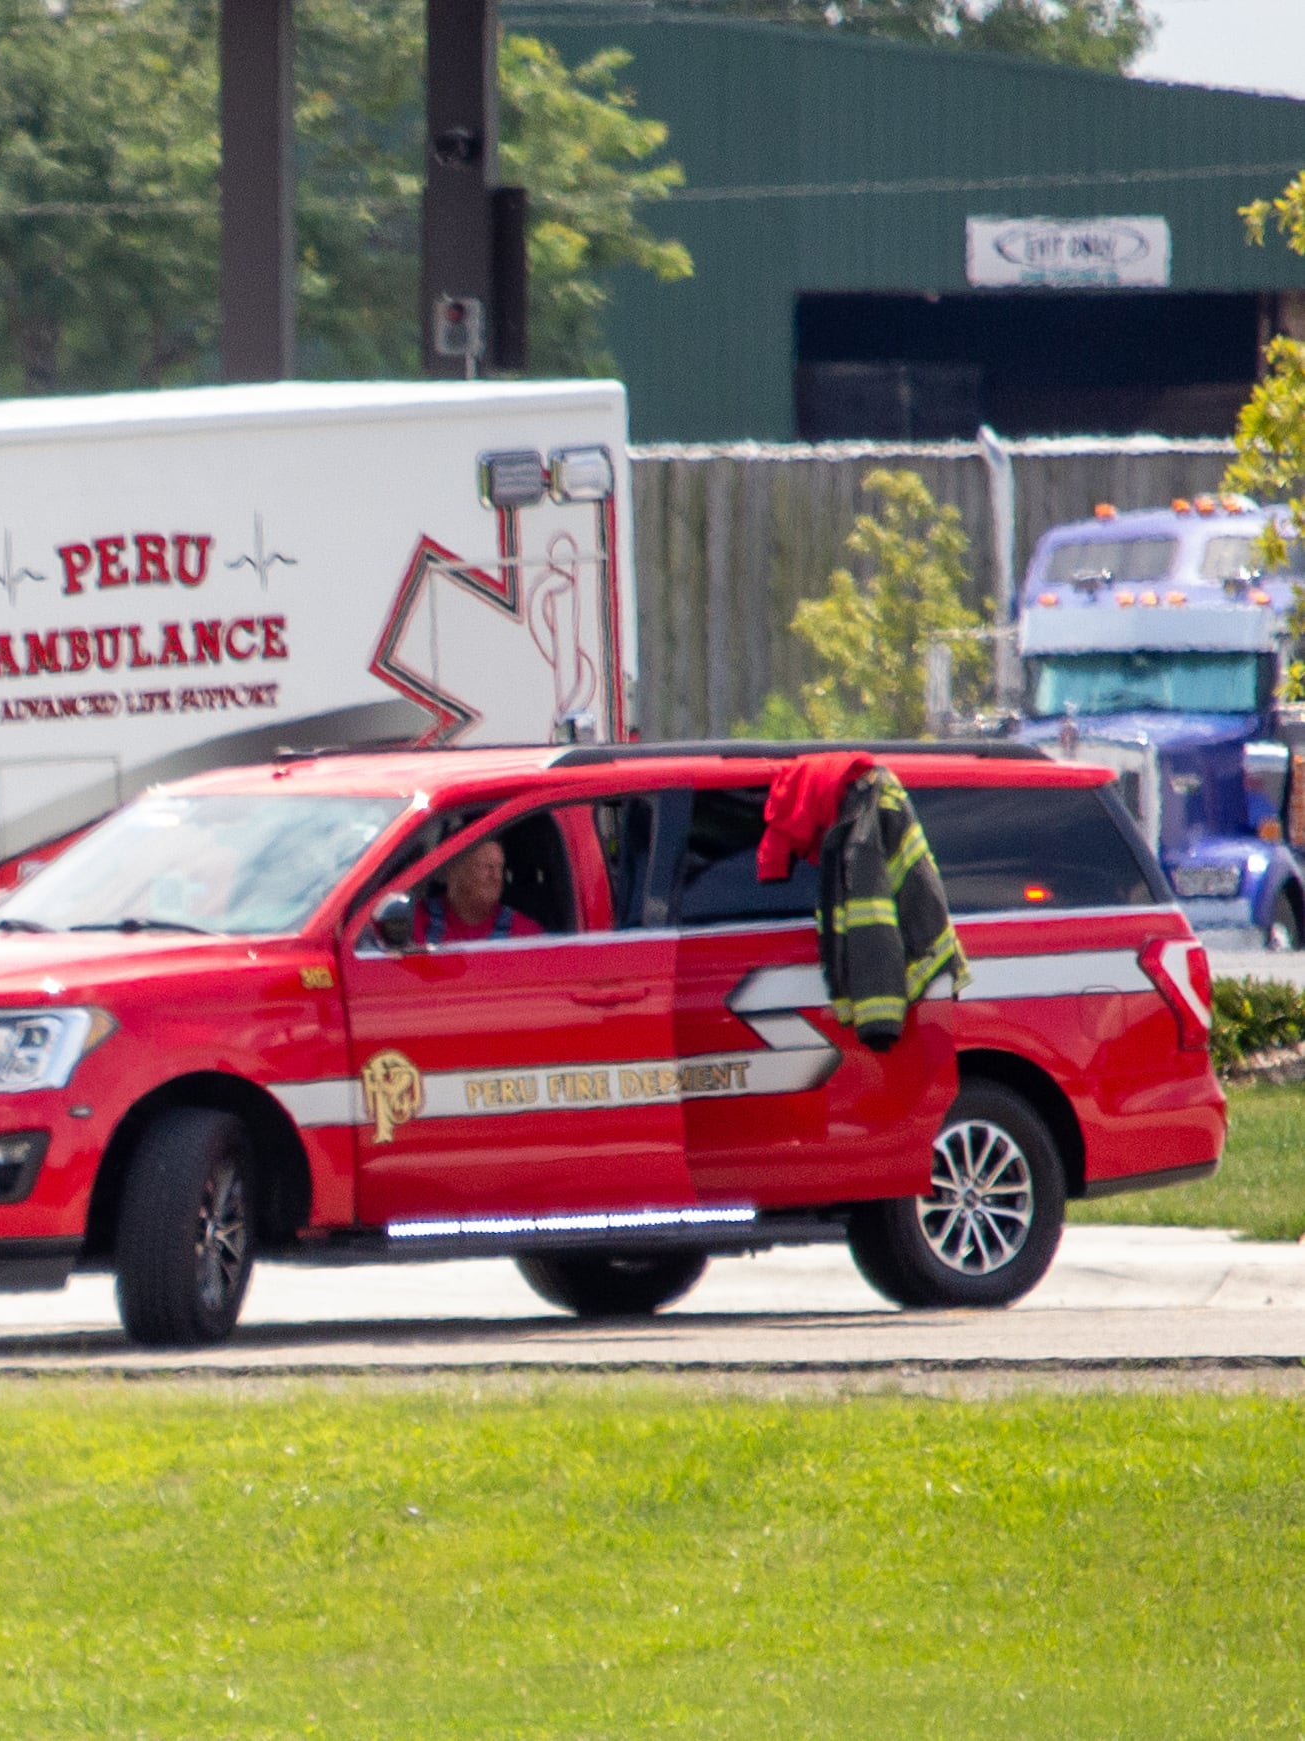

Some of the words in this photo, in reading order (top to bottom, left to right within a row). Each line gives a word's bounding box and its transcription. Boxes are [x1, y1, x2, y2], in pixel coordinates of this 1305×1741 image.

[54, 533, 213, 597] PERU
[124, 690, 174, 715] LIFE
[177, 682, 279, 714] SUPPORT
[465, 1078, 537, 1110] PERU
[547, 1071, 611, 1104] FIRE
